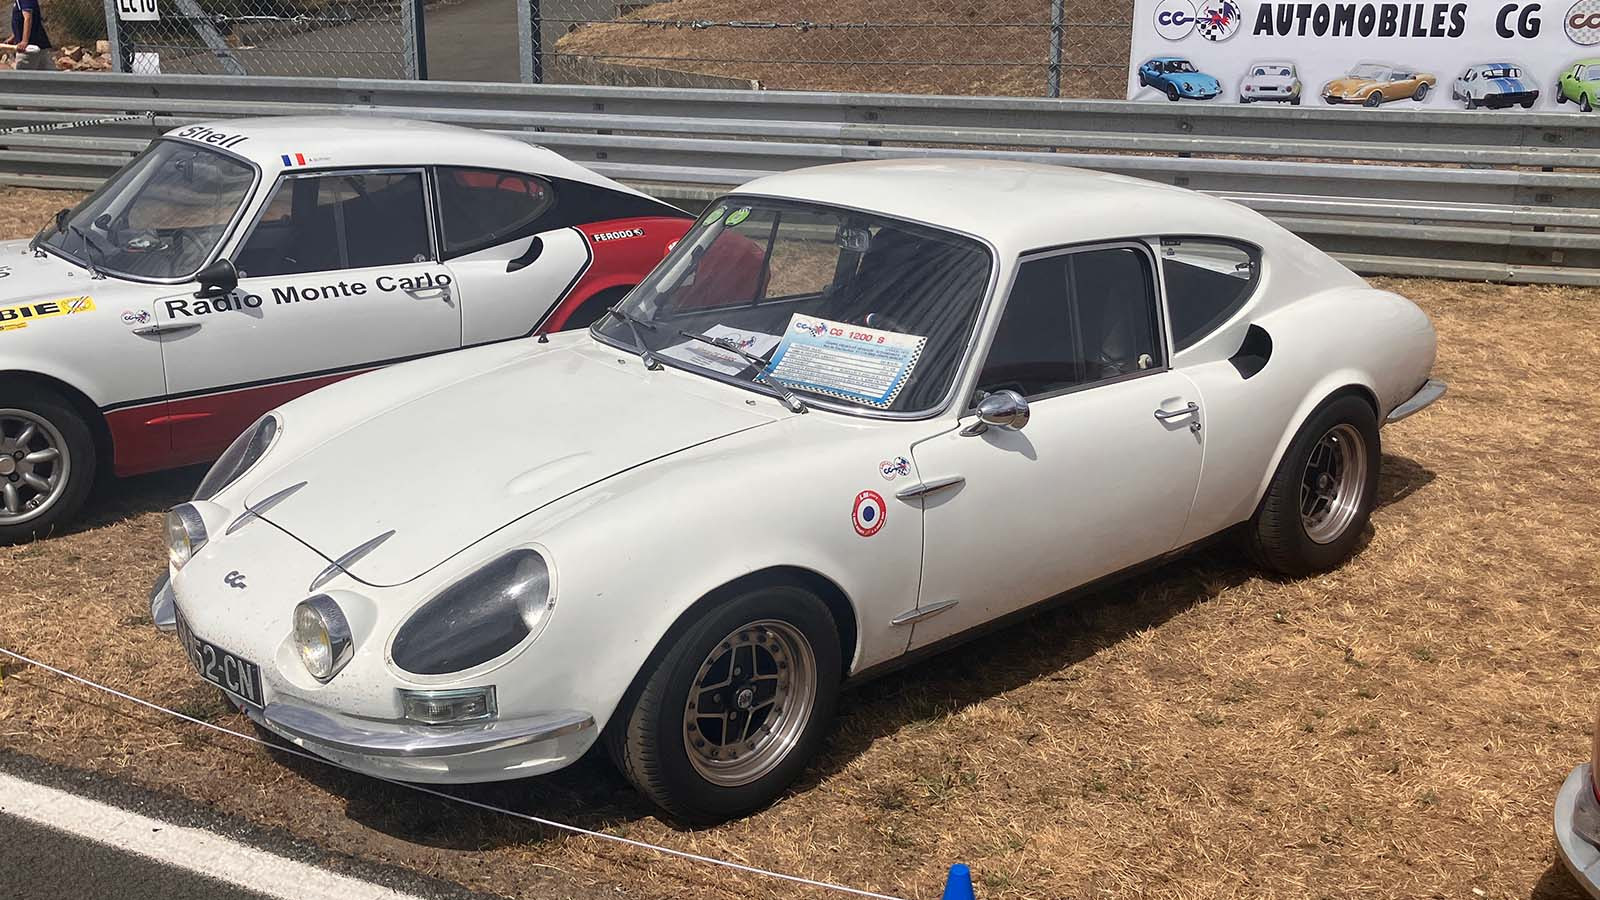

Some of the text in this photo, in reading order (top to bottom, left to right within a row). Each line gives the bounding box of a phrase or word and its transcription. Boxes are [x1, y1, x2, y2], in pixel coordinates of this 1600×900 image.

[1253, 3, 1541, 39] AUTOMOBILES CG
[178, 126, 249, 149] Shell
[594, 229, 634, 243] FERODO
[165, 272, 452, 319] Radio Monte Carlo
[829, 327, 844, 337] CG
[848, 331, 873, 343] 1200
